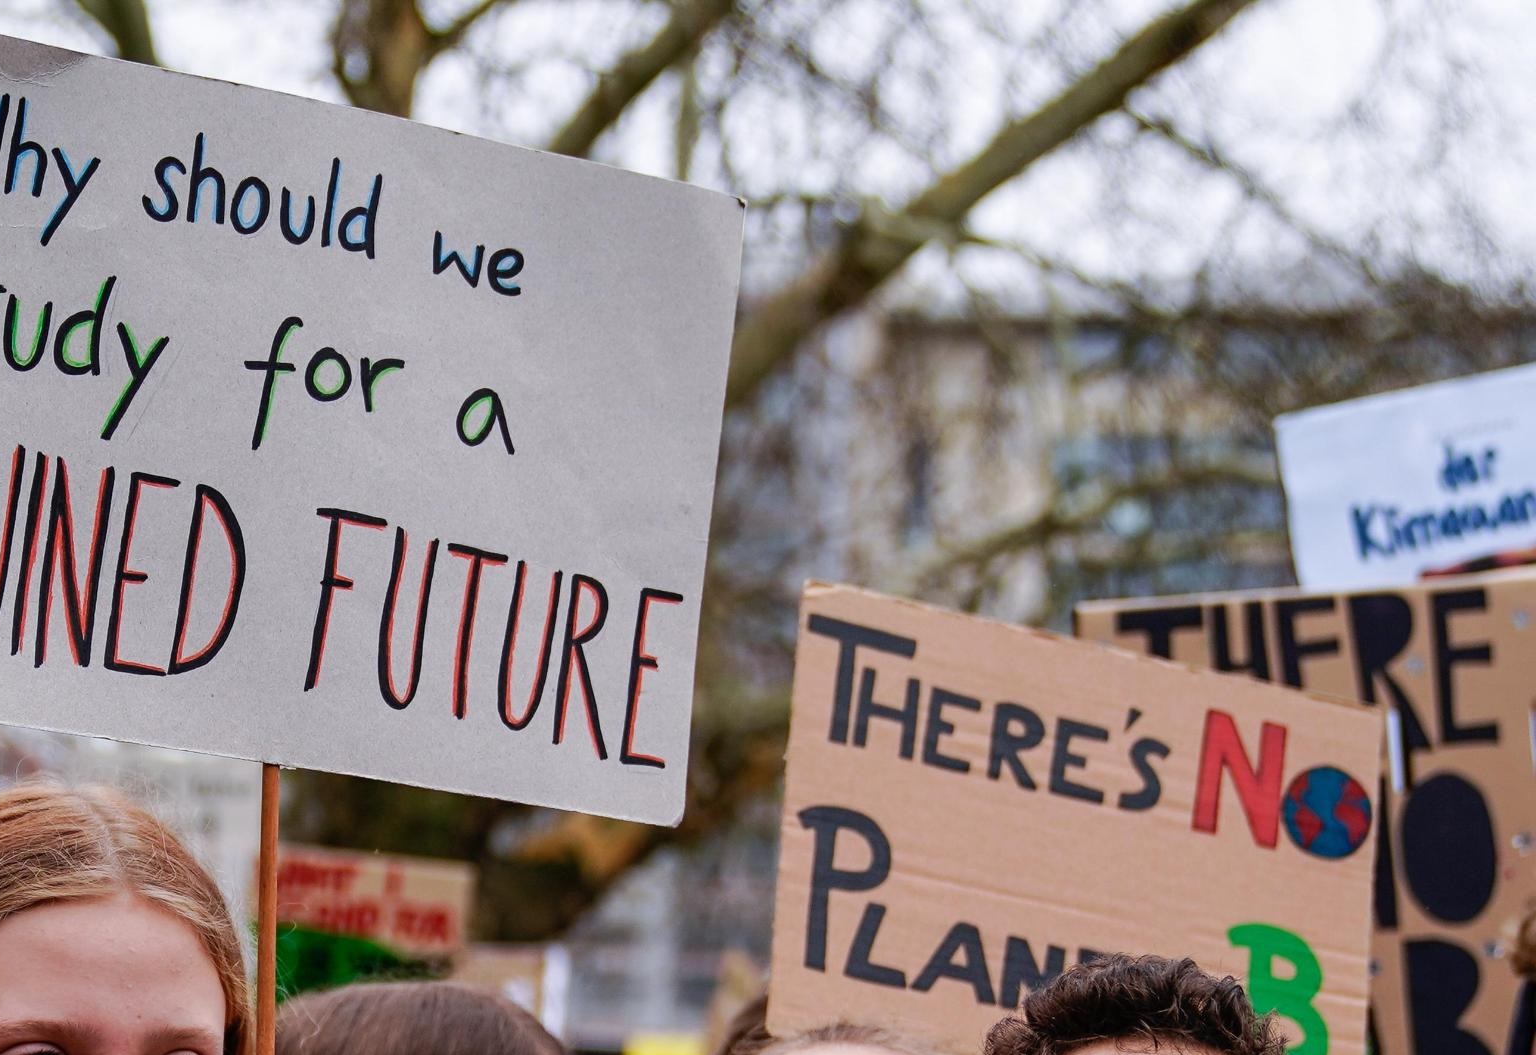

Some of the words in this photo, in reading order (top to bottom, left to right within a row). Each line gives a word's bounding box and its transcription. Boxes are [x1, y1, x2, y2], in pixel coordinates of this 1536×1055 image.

[142, 132, 382, 260] should
[432, 230, 525, 296] we
[244, 316, 405, 450] for
[456, 387, 515, 455] a
[303, 507, 684, 769] FUTURE
[808, 613, 1171, 812] THERE'S
[796, 805, 1112, 1009] PLAN
